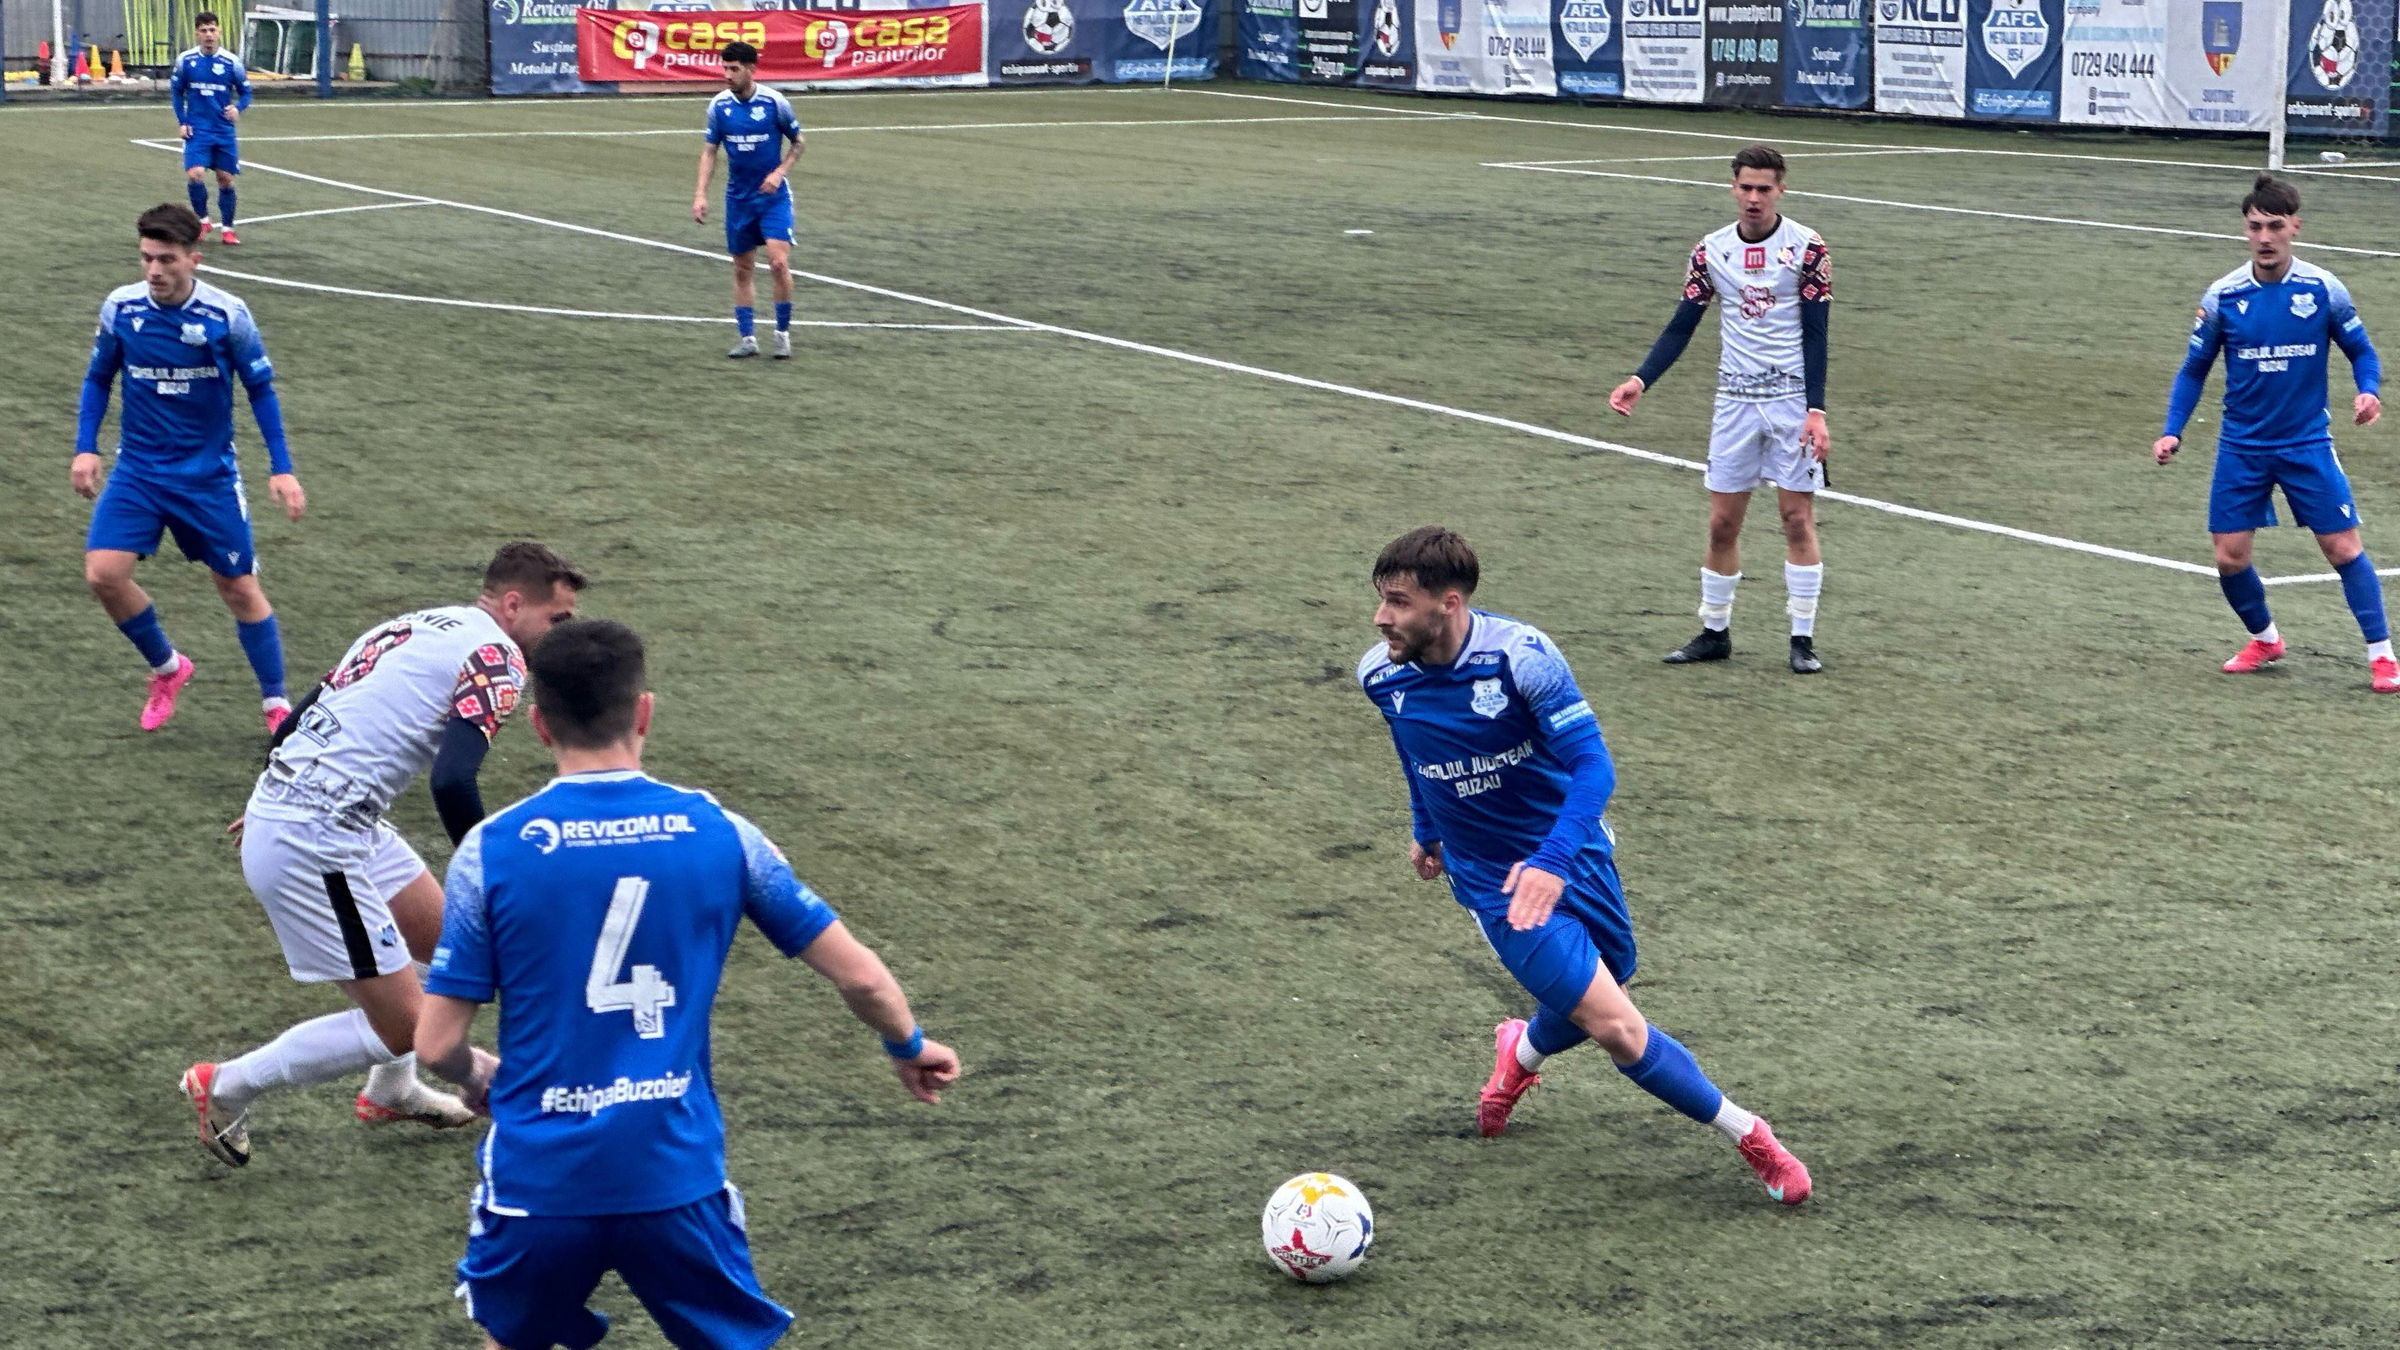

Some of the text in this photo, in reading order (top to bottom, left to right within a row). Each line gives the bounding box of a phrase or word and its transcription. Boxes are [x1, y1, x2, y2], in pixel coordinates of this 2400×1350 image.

[1570, 4, 1601, 17] AFC
[1997, 12, 2035, 26] AFC
[665, 22, 765, 50] casa
[855, 16, 949, 47] casa
[851, 47, 947, 67] pariurilor
[2071, 52, 2155, 79] 0729 494 444
[562, 814, 697, 840] REVICOM OIL
[586, 876, 676, 1041] 4
